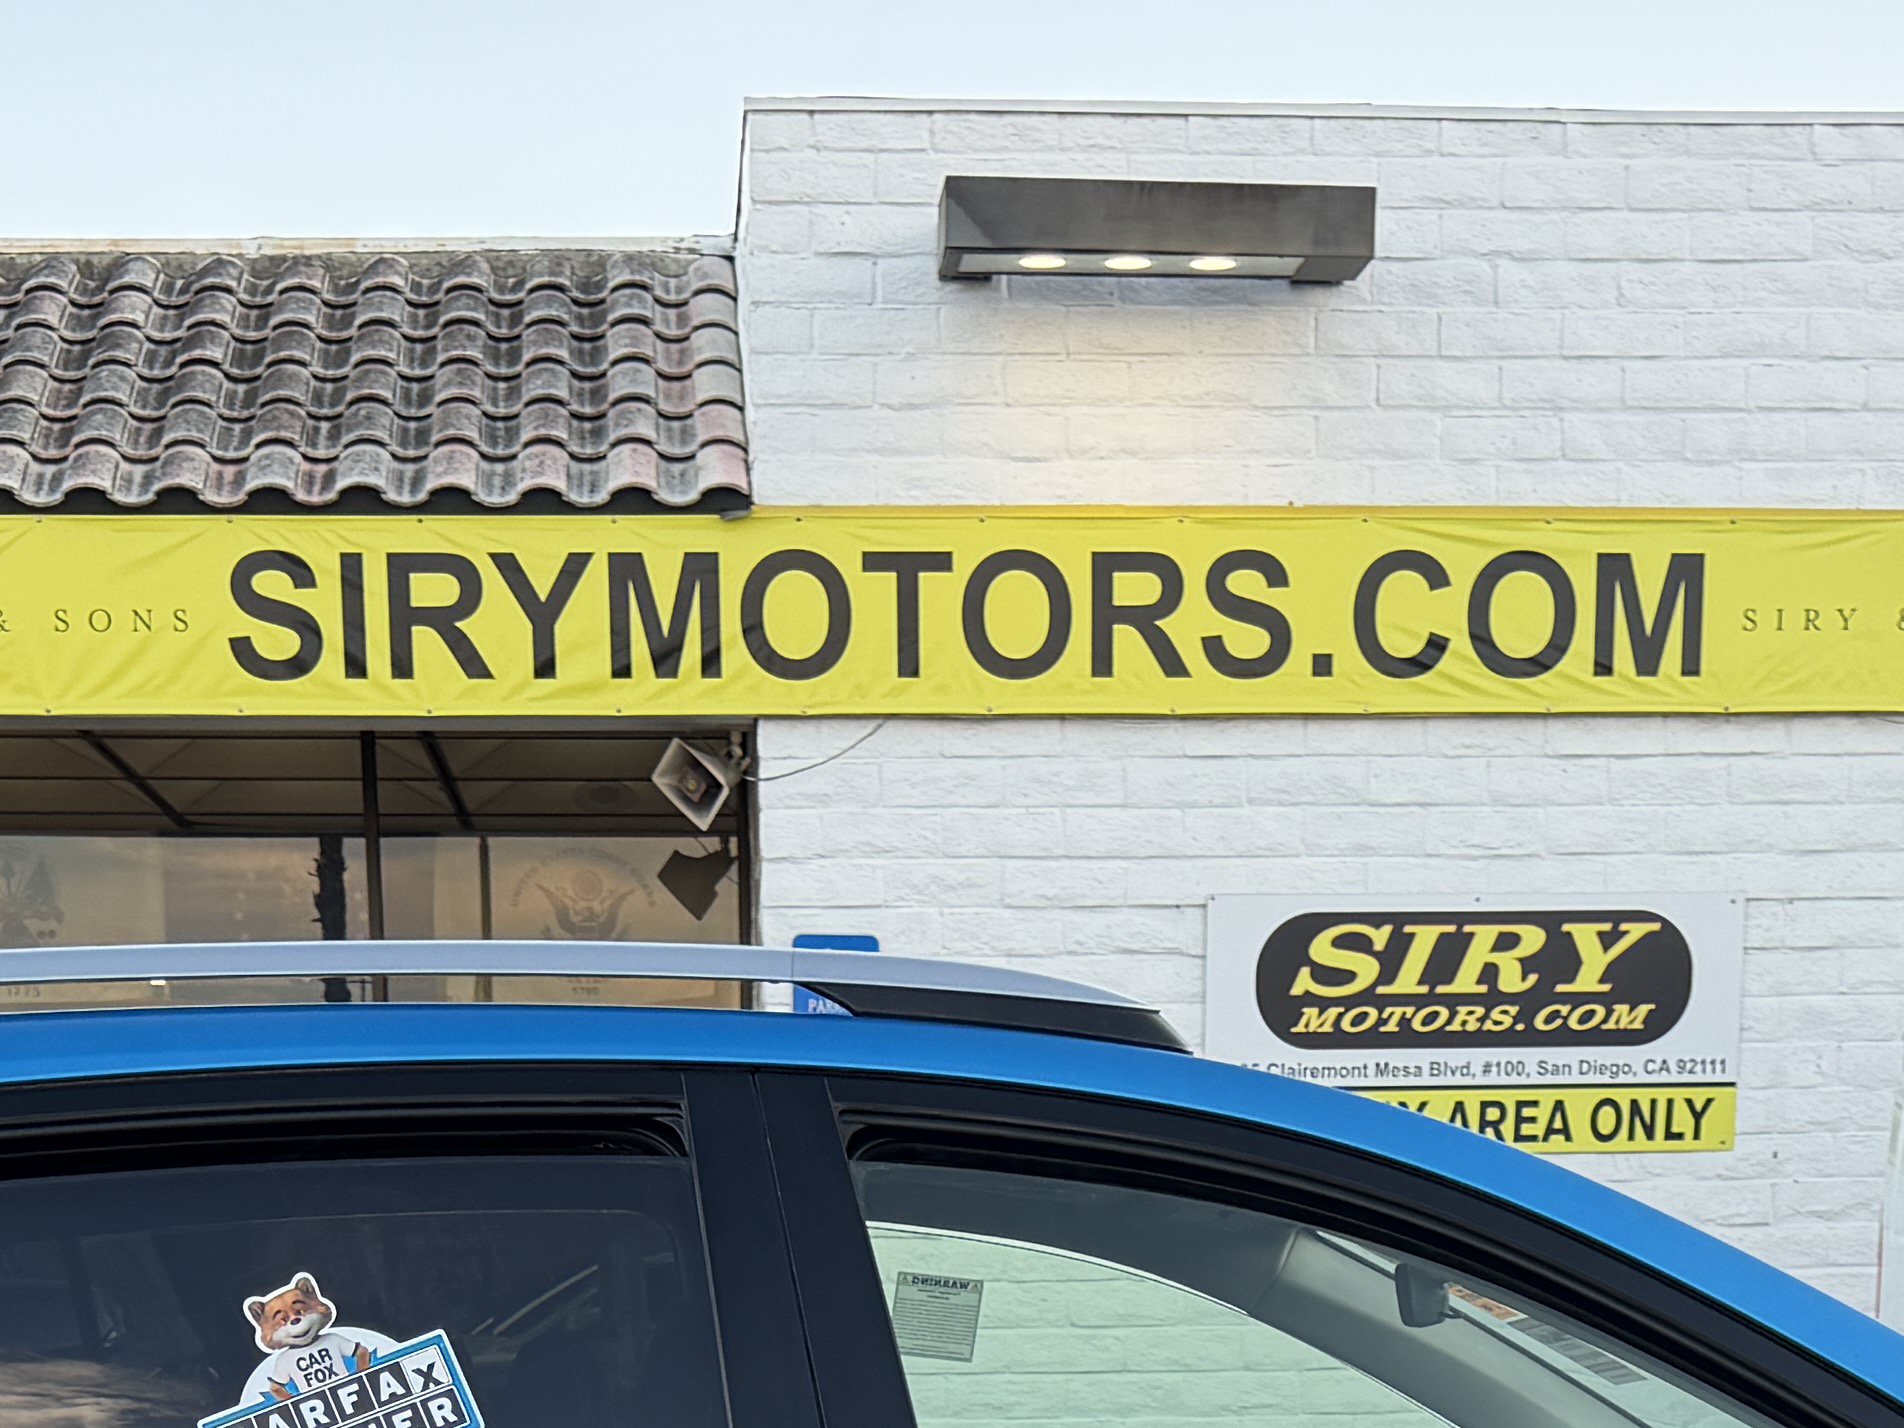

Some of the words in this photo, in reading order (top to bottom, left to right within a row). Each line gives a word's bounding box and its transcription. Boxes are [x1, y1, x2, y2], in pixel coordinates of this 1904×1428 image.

[55, 607, 192, 634] SONS
[228, 549, 1706, 681] SIRYMOTORS.COM
[1741, 606, 1859, 633] SIRY
[1289, 922, 1661, 997] SIRY
[1290, 1003, 1656, 1033] MOTORS.COM
[1375, 1061, 1425, 1079] Mesa
[1429, 1060, 1476, 1080] Blvd,
[1481, 1060, 1531, 1079] #100,
[1536, 1060, 1574, 1077] San
[1579, 1059, 1637, 1080] Diego,
[1643, 1058, 1671, 1075] CA
[1675, 1057, 1728, 1076] 92111
[1448, 1100, 1574, 1143] AREA
[1590, 1098, 1716, 1142] ONLY
[296, 1348, 333, 1372] CAR
[303, 1363, 341, 1387] FOX
